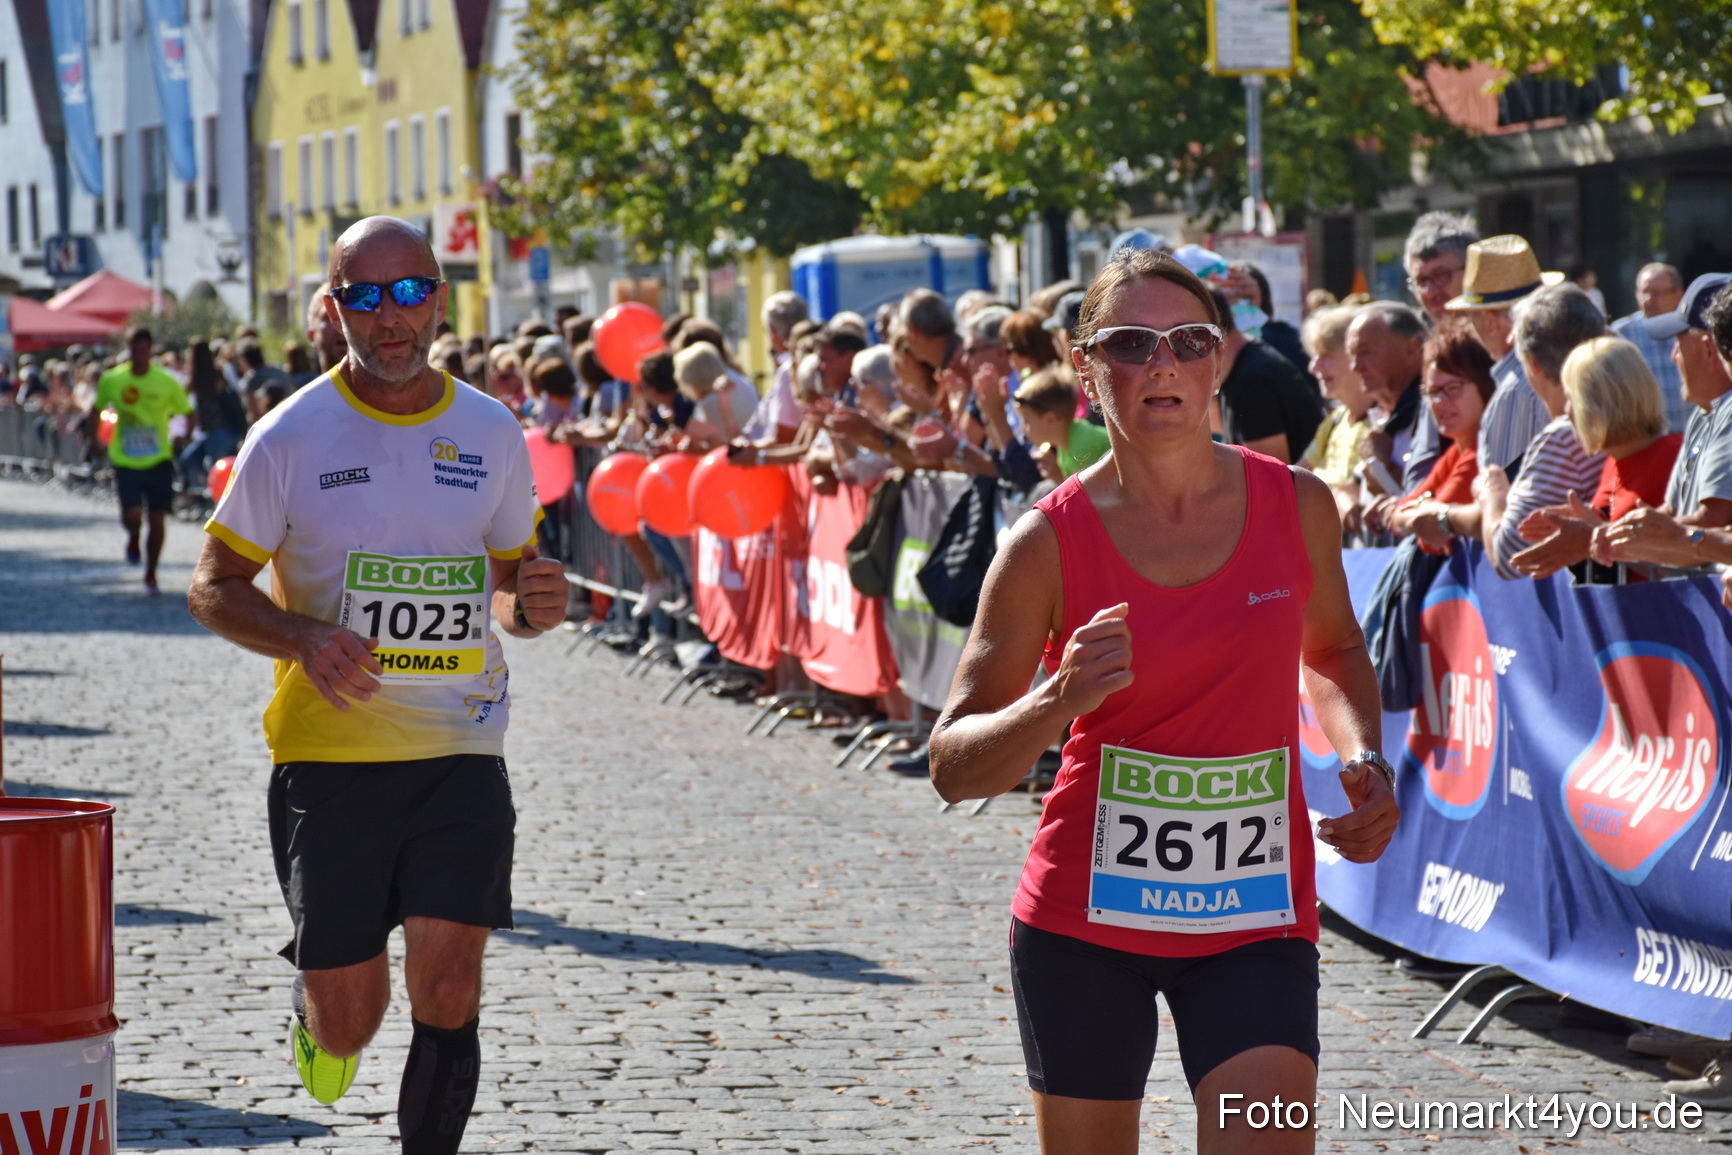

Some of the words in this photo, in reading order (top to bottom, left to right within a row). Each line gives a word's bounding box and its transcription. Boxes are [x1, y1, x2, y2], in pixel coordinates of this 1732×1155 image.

[434, 442, 457, 461] 20
[460, 455, 480, 463] JAHRE
[320, 467, 369, 485] BOCK
[434, 462, 488, 478] Neumarkter
[434, 475, 478, 491] Stadtlauf
[358, 557, 477, 590] BOCK
[362, 601, 471, 641] 1023
[476, 604, 482, 612] B
[1575, 703, 1711, 828] hervis
[1112, 756, 1275, 804] BOCK
[1274, 817, 1281, 825] C
[1581, 803, 1627, 837] SPORTS
[1116, 815, 1266, 871] 2612
[1141, 888, 1241, 912] NADJA
[1634, 926, 1673, 987] GET
